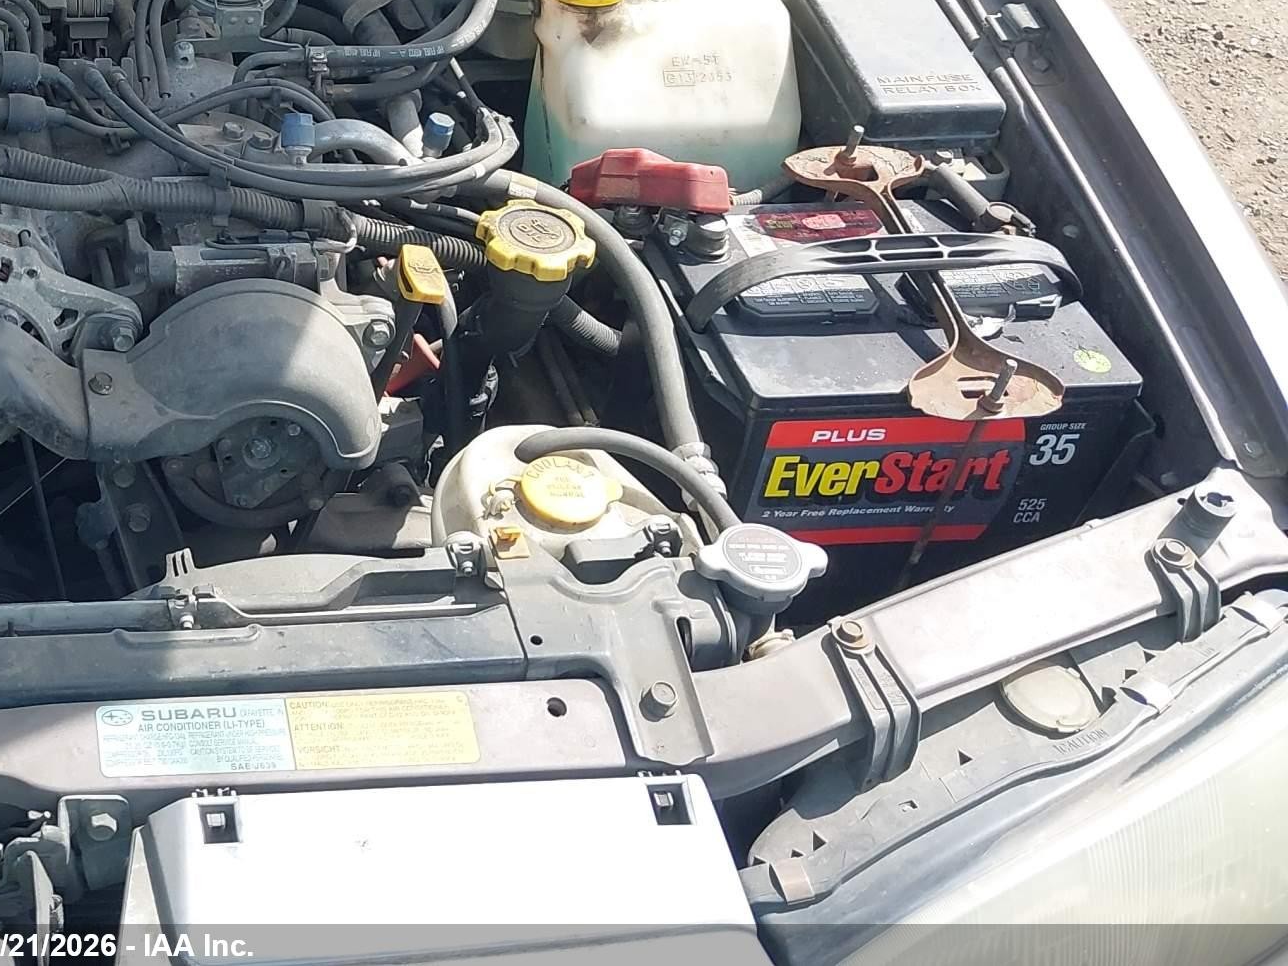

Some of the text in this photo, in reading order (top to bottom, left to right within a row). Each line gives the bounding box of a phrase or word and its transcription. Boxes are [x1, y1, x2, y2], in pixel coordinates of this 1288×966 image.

[926, 73, 974, 82] FUSE
[882, 85, 938, 94] RELAY
[1040, 422, 1087, 431] GROUP SIZE
[812, 428, 886, 443] PLUS
[1029, 433, 1081, 466] 35
[764, 449, 1010, 498] EverStart
[1018, 498, 1047, 511] 525
[762, 510, 771, 518] 2
[774, 509, 798, 518] Year
[800, 508, 825, 517] Free
[828, 506, 902, 517] Replacement
[1013, 511, 1041, 523] CCA
[141, 707, 237, 722] SUBARU
[138, 723, 154, 732] AIR
[156, 721, 222, 732] CONDITIONER
[231, 763, 251, 771] SAE
